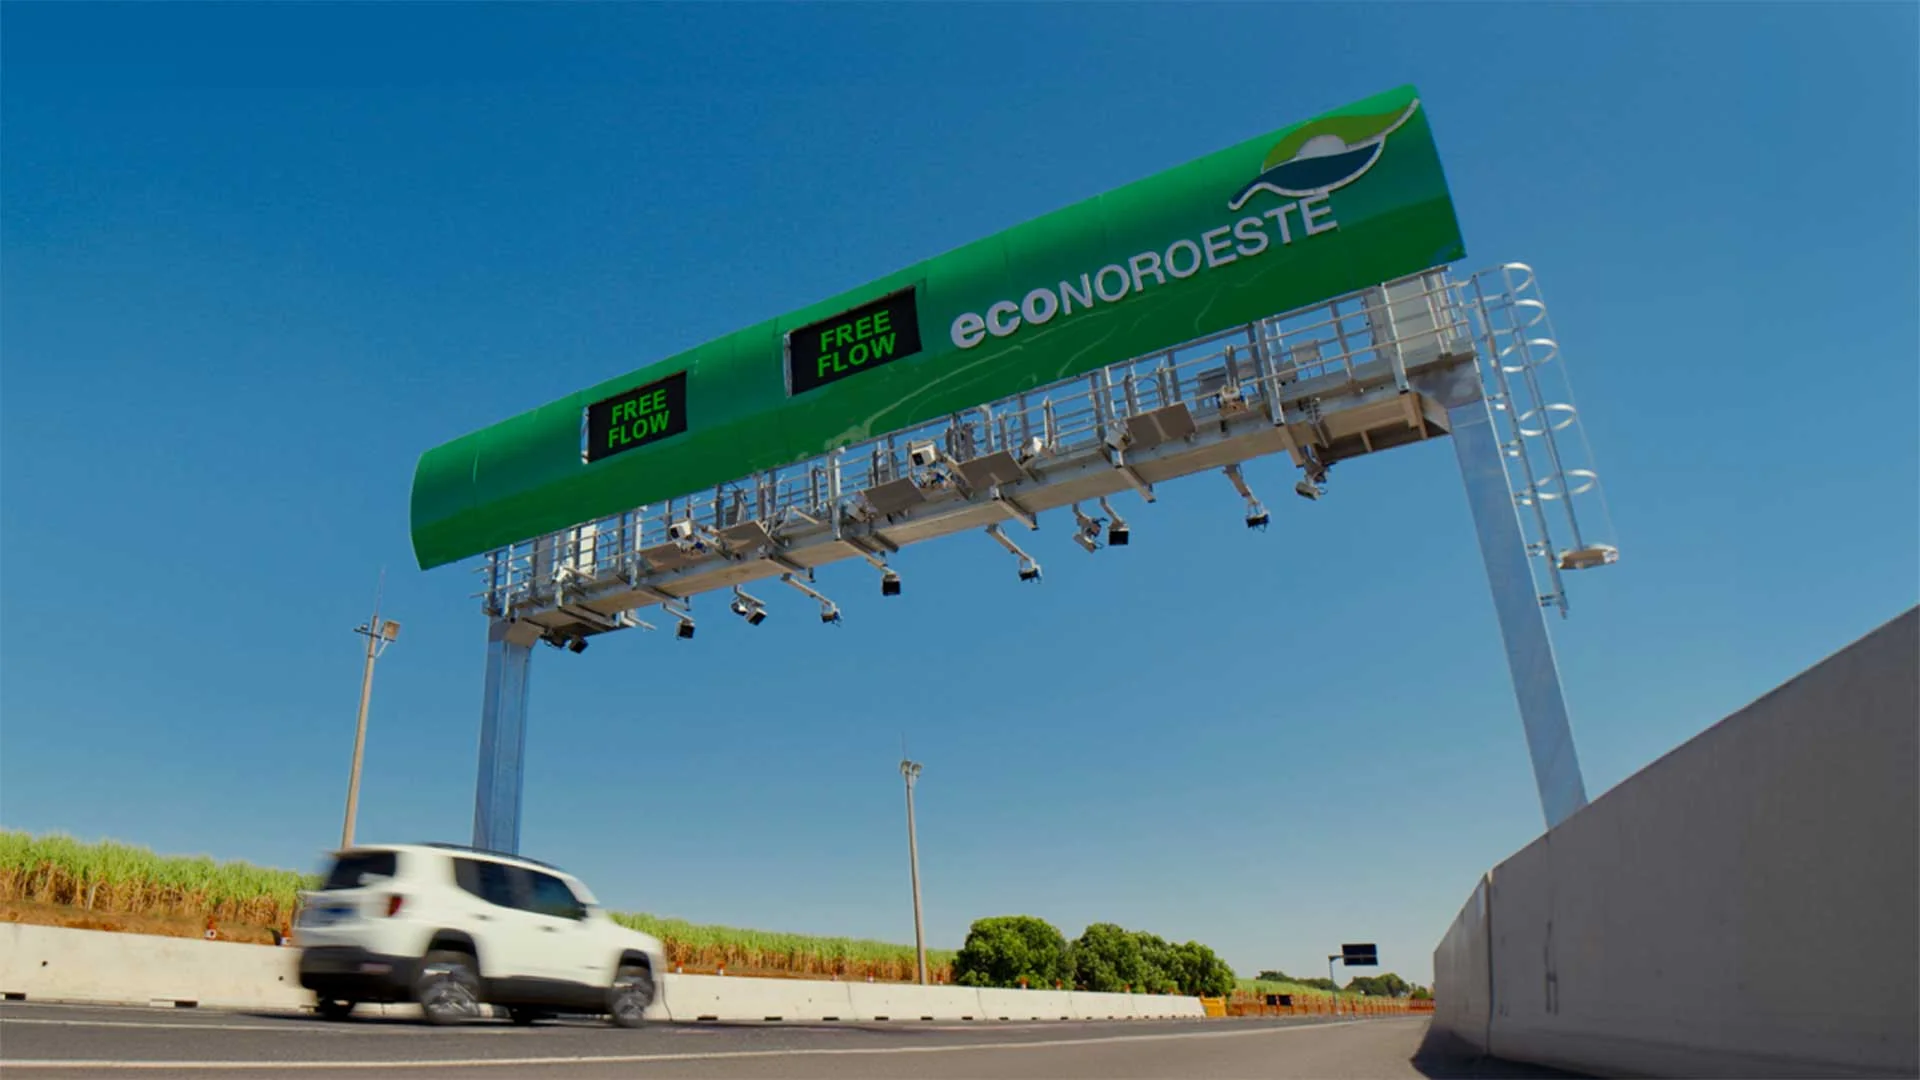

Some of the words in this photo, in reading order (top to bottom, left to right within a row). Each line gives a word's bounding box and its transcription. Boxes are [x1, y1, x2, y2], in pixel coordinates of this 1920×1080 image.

[951, 195, 1337, 348] ecoNOROESTE
[820, 311, 891, 352] FREE
[817, 333, 896, 377] FLOW
[611, 390, 666, 425] FREE
[608, 411, 669, 448] FLOW
